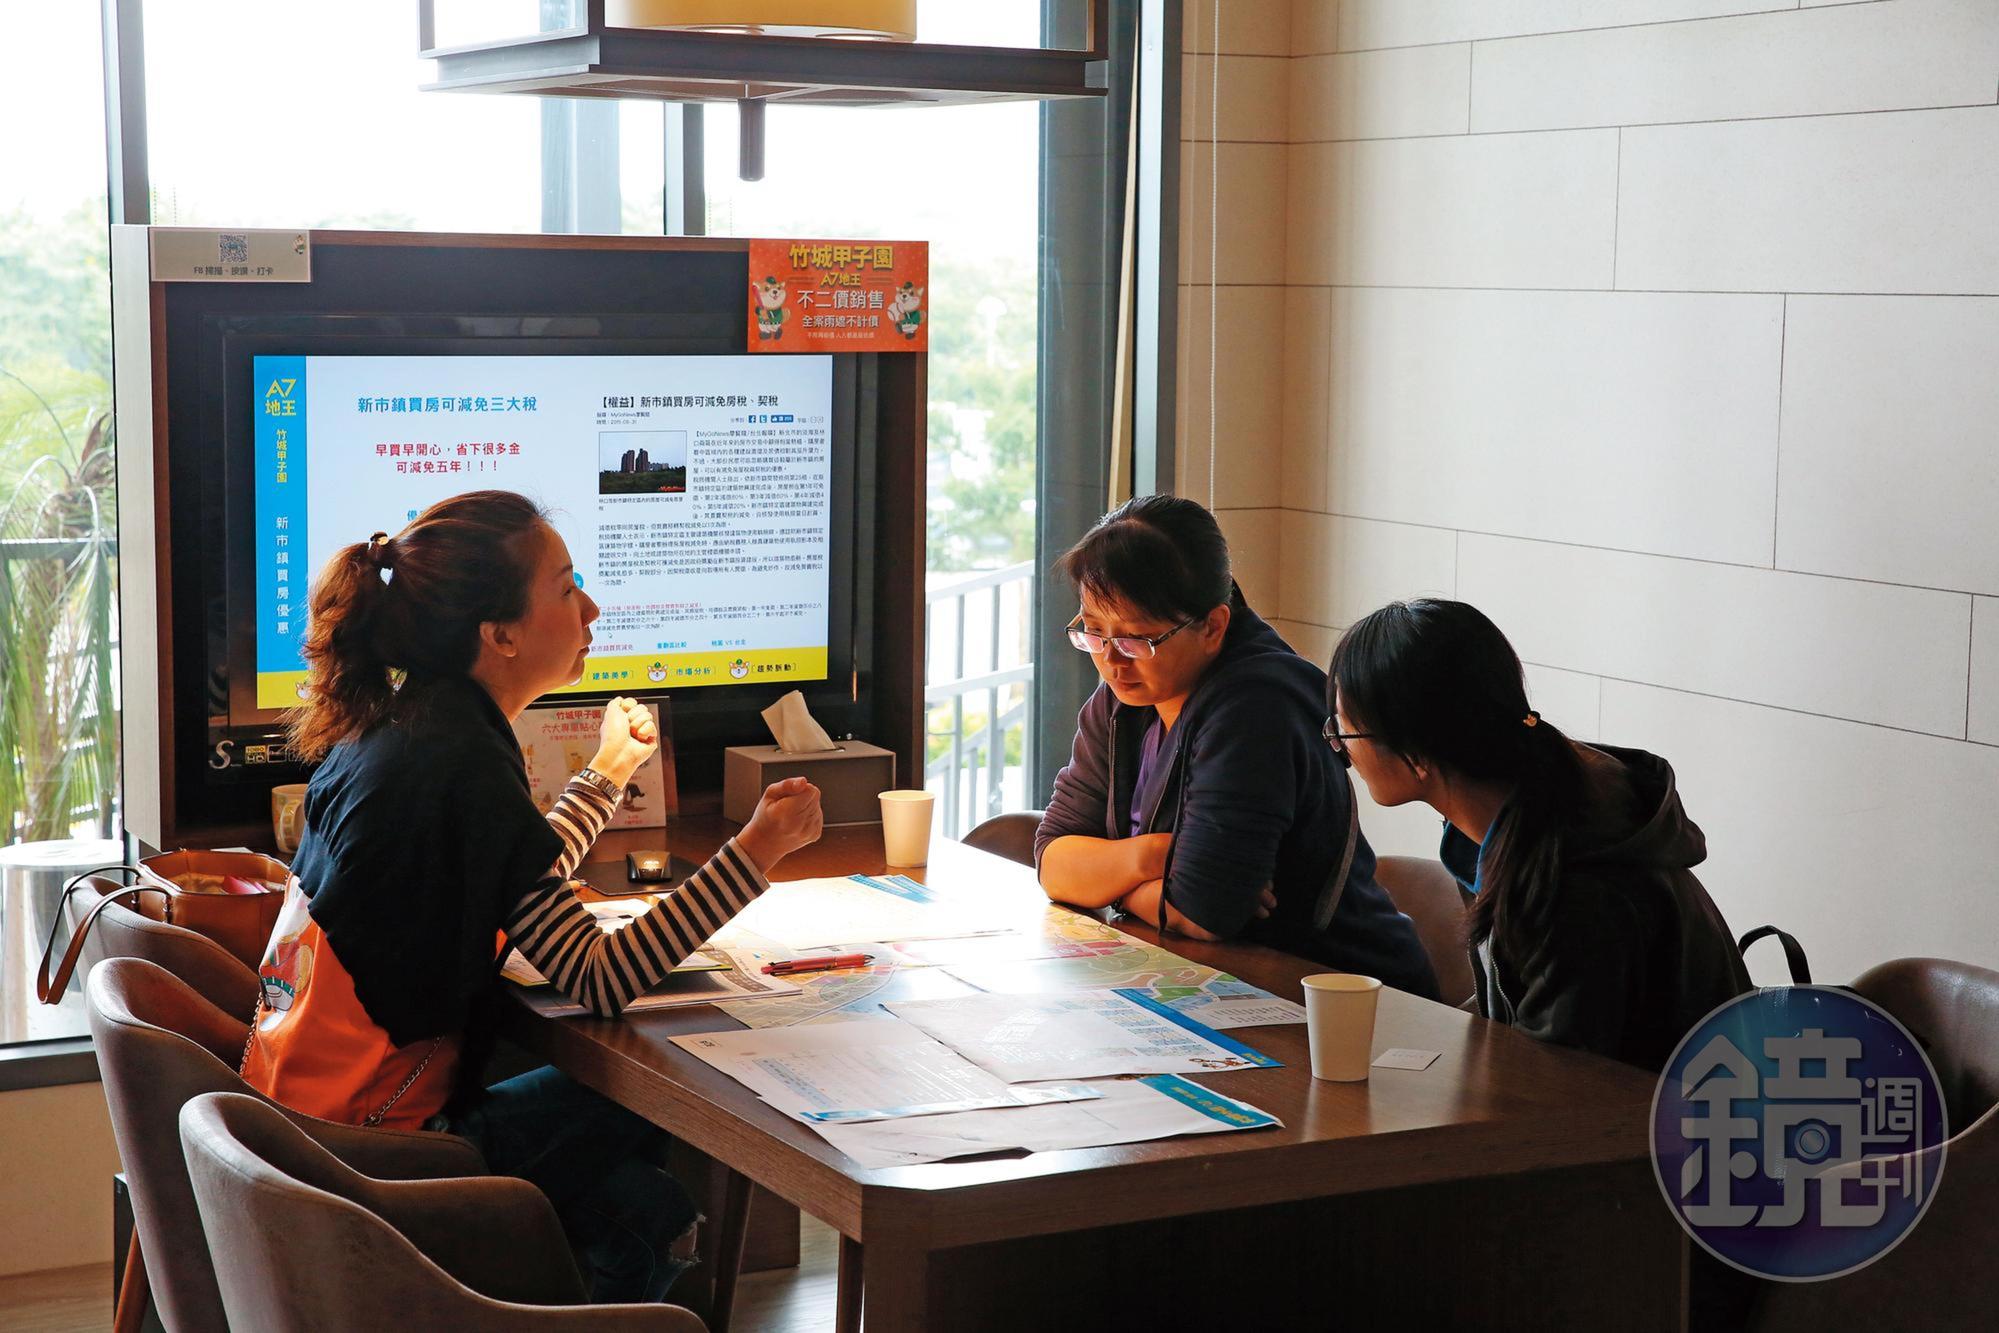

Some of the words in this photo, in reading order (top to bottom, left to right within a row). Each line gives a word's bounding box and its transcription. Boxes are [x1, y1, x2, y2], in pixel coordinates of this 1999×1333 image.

[789, 244, 893, 269] 竹城甲子園
[821, 272, 862, 286] A7地王
[797, 290, 884, 309] 不二價銷售
[265, 379, 297, 398] A7
[265, 399, 297, 416] 地王
[358, 396, 537, 413] 新市鎮買房可減免三大稅
[276, 429, 288, 483] 竹城甲子園
[276, 517, 290, 634] 新市鎮買房優惠
